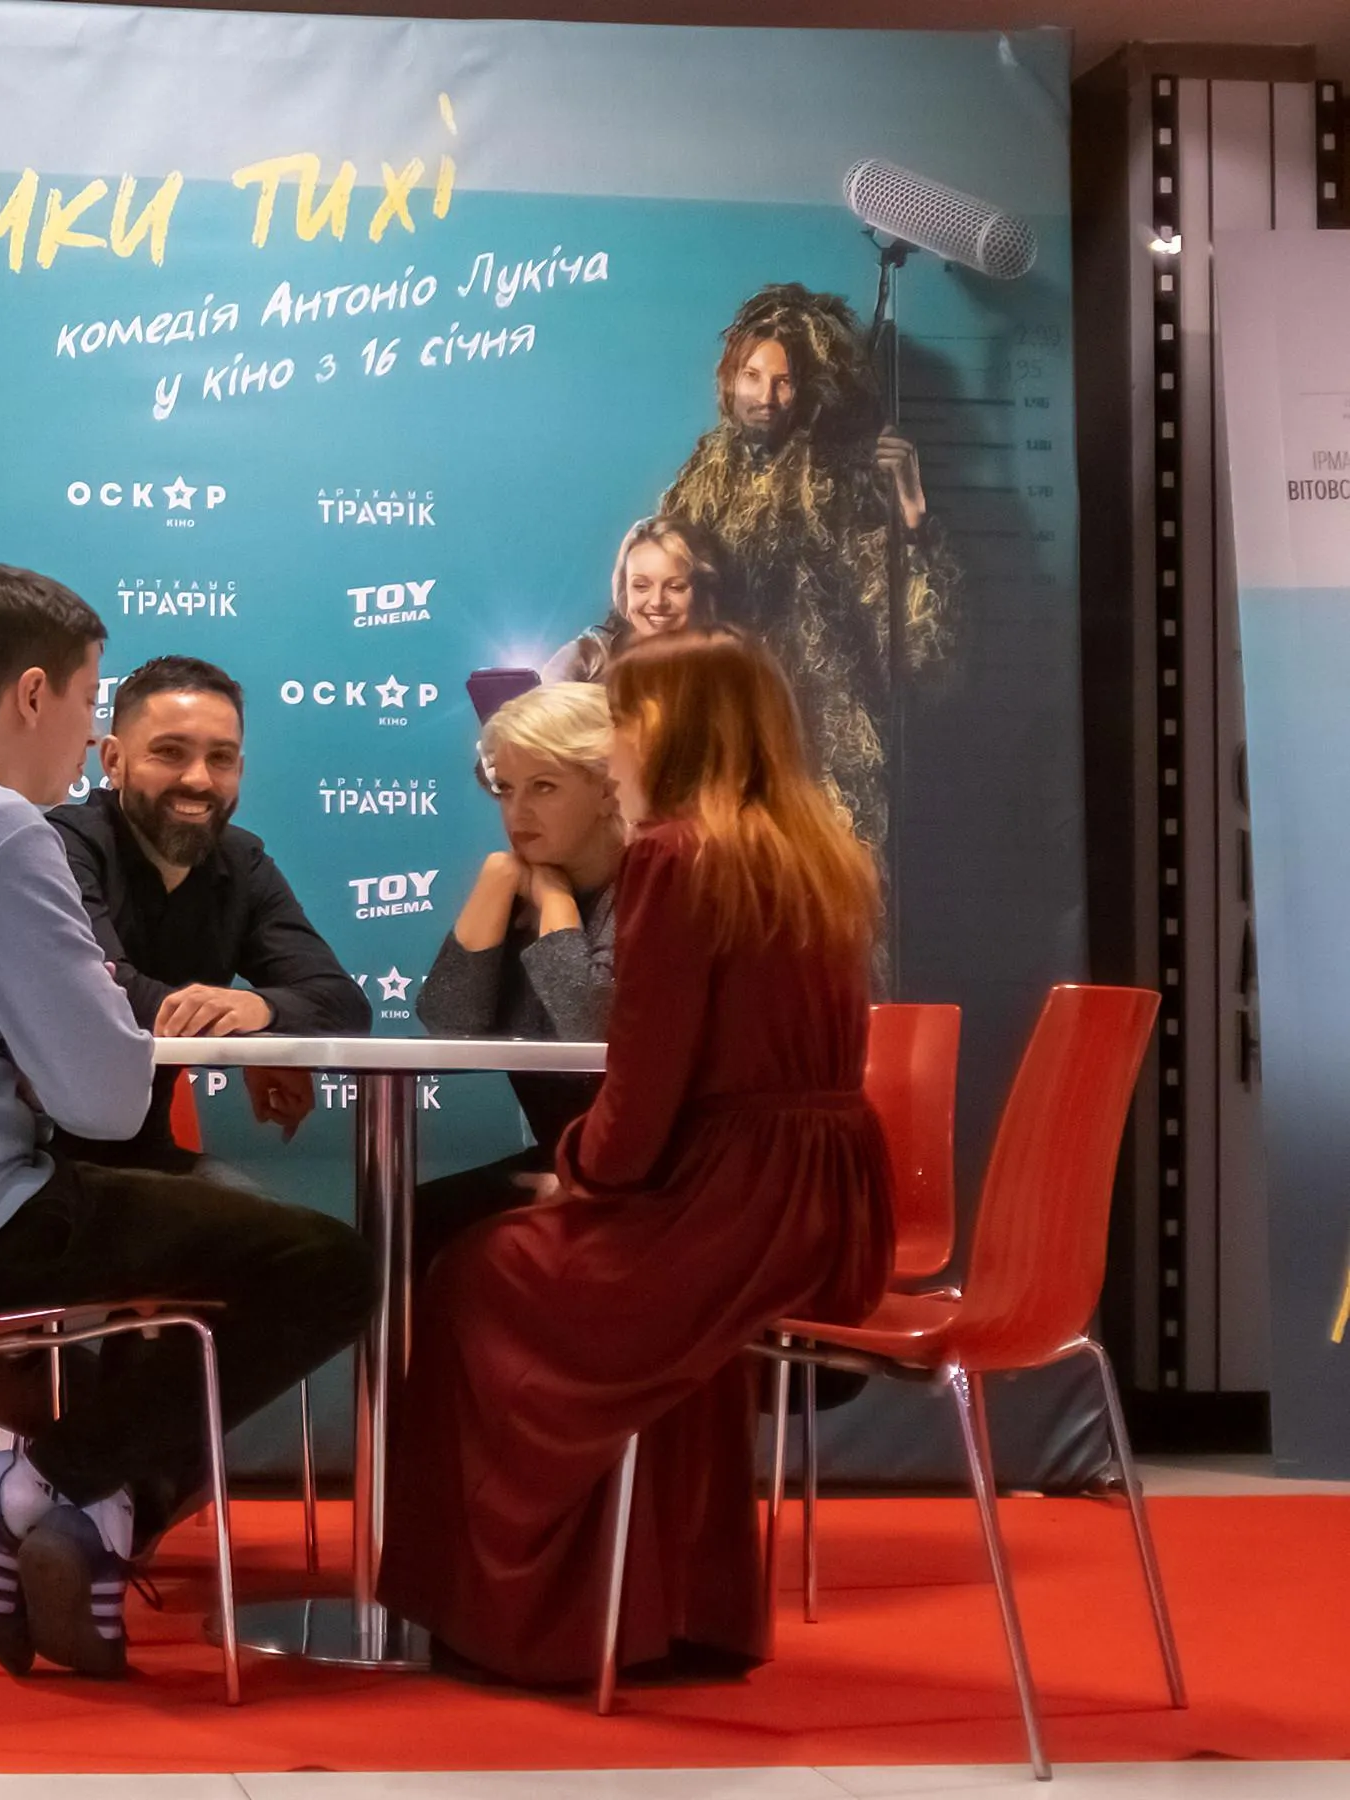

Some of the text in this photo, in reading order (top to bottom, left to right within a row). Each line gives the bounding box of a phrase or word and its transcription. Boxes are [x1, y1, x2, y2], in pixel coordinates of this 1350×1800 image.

[56, 244, 608, 359] комедія Антоніо Лукіча
[152, 372, 181, 421] у
[203, 352, 295, 402] кіно
[361, 337, 398, 377] 16
[420, 322, 536, 367] січня
[166, 519, 195, 527] КІНО
[317, 499, 435, 525] ТРАФІК
[117, 591, 237, 616] ТРАФІК
[346, 580, 436, 613] TOY
[353, 609, 431, 627] CINEMA
[378, 717, 408, 726] КІНО
[319, 790, 438, 815] ТРАФІК
[348, 870, 439, 906] TOY
[355, 899, 434, 919] CINEMA
